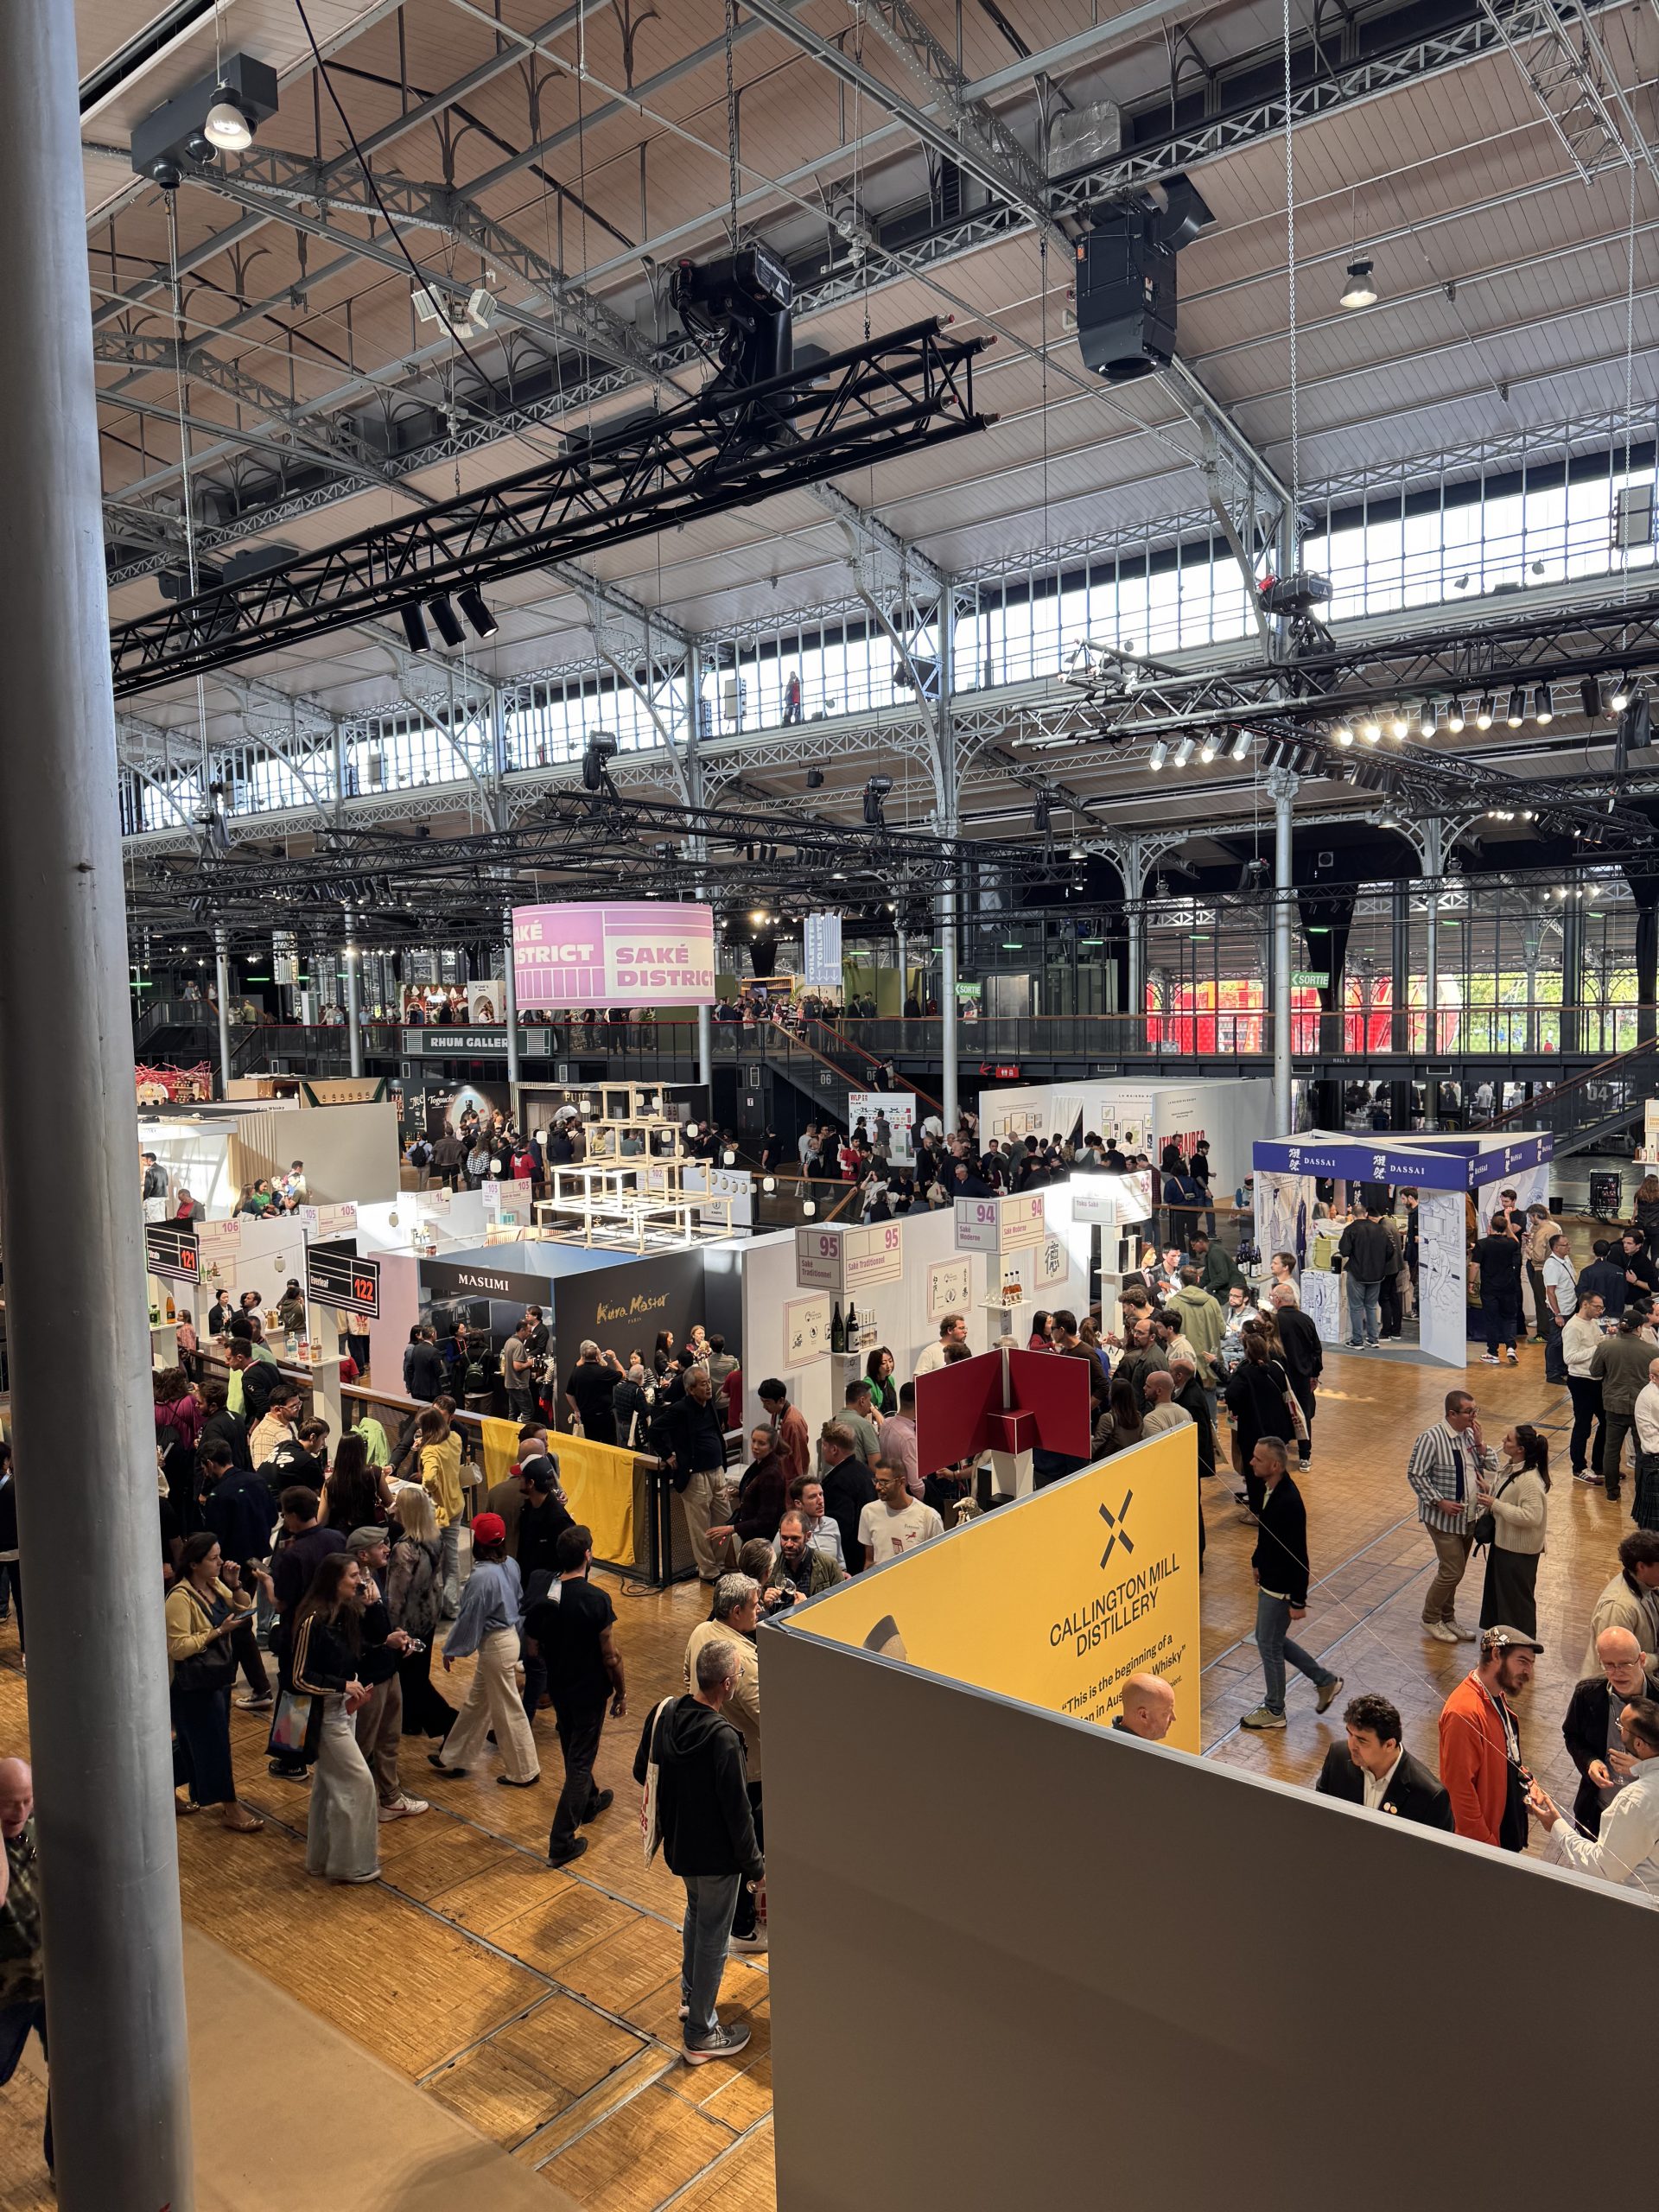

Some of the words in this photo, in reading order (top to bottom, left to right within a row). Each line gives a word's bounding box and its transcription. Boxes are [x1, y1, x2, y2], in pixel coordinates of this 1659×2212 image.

[513, 919, 543, 942] AKÉ
[514, 944, 594, 965] ISTRICT
[616, 944, 689, 964] SAKÉ
[1298, 975, 1329, 985] SORTIE
[959, 985, 982, 994] SORTIE
[430, 1037, 463, 1048] RHUM
[466, 1037, 508, 1049] GALLER
[820, 1074, 831, 1084] 06
[428, 1093, 454, 1106] Togouchi
[1586, 1085, 1609, 1102] 04
[1304, 1157, 1336, 1166] DASSAI
[652, 1169, 663, 1178] 102
[1389, 1165, 1425, 1175] DASSAI
[1474, 1163, 1488, 1175] DASSAI
[487, 1184, 498, 1193] 103
[518, 1180, 530, 1192] 103
[305, 1208, 316, 1219] 105
[340, 1205, 355, 1216] 105
[1031, 1198, 1042, 1217] 94
[976, 1205, 995, 1224] 94
[221, 1221, 239, 1233] 106
[1003, 1227, 1012, 1236] Saké
[1012, 1224, 1027, 1234] Moderne
[885, 1227, 899, 1249] 95
[959, 1233, 981, 1242] Moderne
[819, 1236, 837, 1258] 95
[181, 1249, 195, 1269] 121
[801, 1259, 813, 1268] Saké
[848, 1261, 859, 1271] Saké
[859, 1255, 885, 1269] Traditionnel
[801, 1268, 831, 1279] Traditionnel
[458, 1273, 509, 1292] MASUMI
[354, 1278, 373, 1301] 122
[596, 1301, 628, 1324] Kura
[629, 1293, 671, 1314] Master
[1049, 1570, 1147, 1647] CALLINGTON
[1149, 1553, 1180, 1591] MILL
[1077, 1586, 1159, 1657] DISTILLERY
[1062, 1691, 1088, 1713] “This
[1089, 1686, 1097, 1699] is
[1098, 1675, 1114, 1693] the
[1115, 1644, 1157, 1681] beginning
[1157, 1634, 1167, 1651] of
[1167, 1634, 1173, 1645] a
[1096, 1705, 1105, 1719] in
